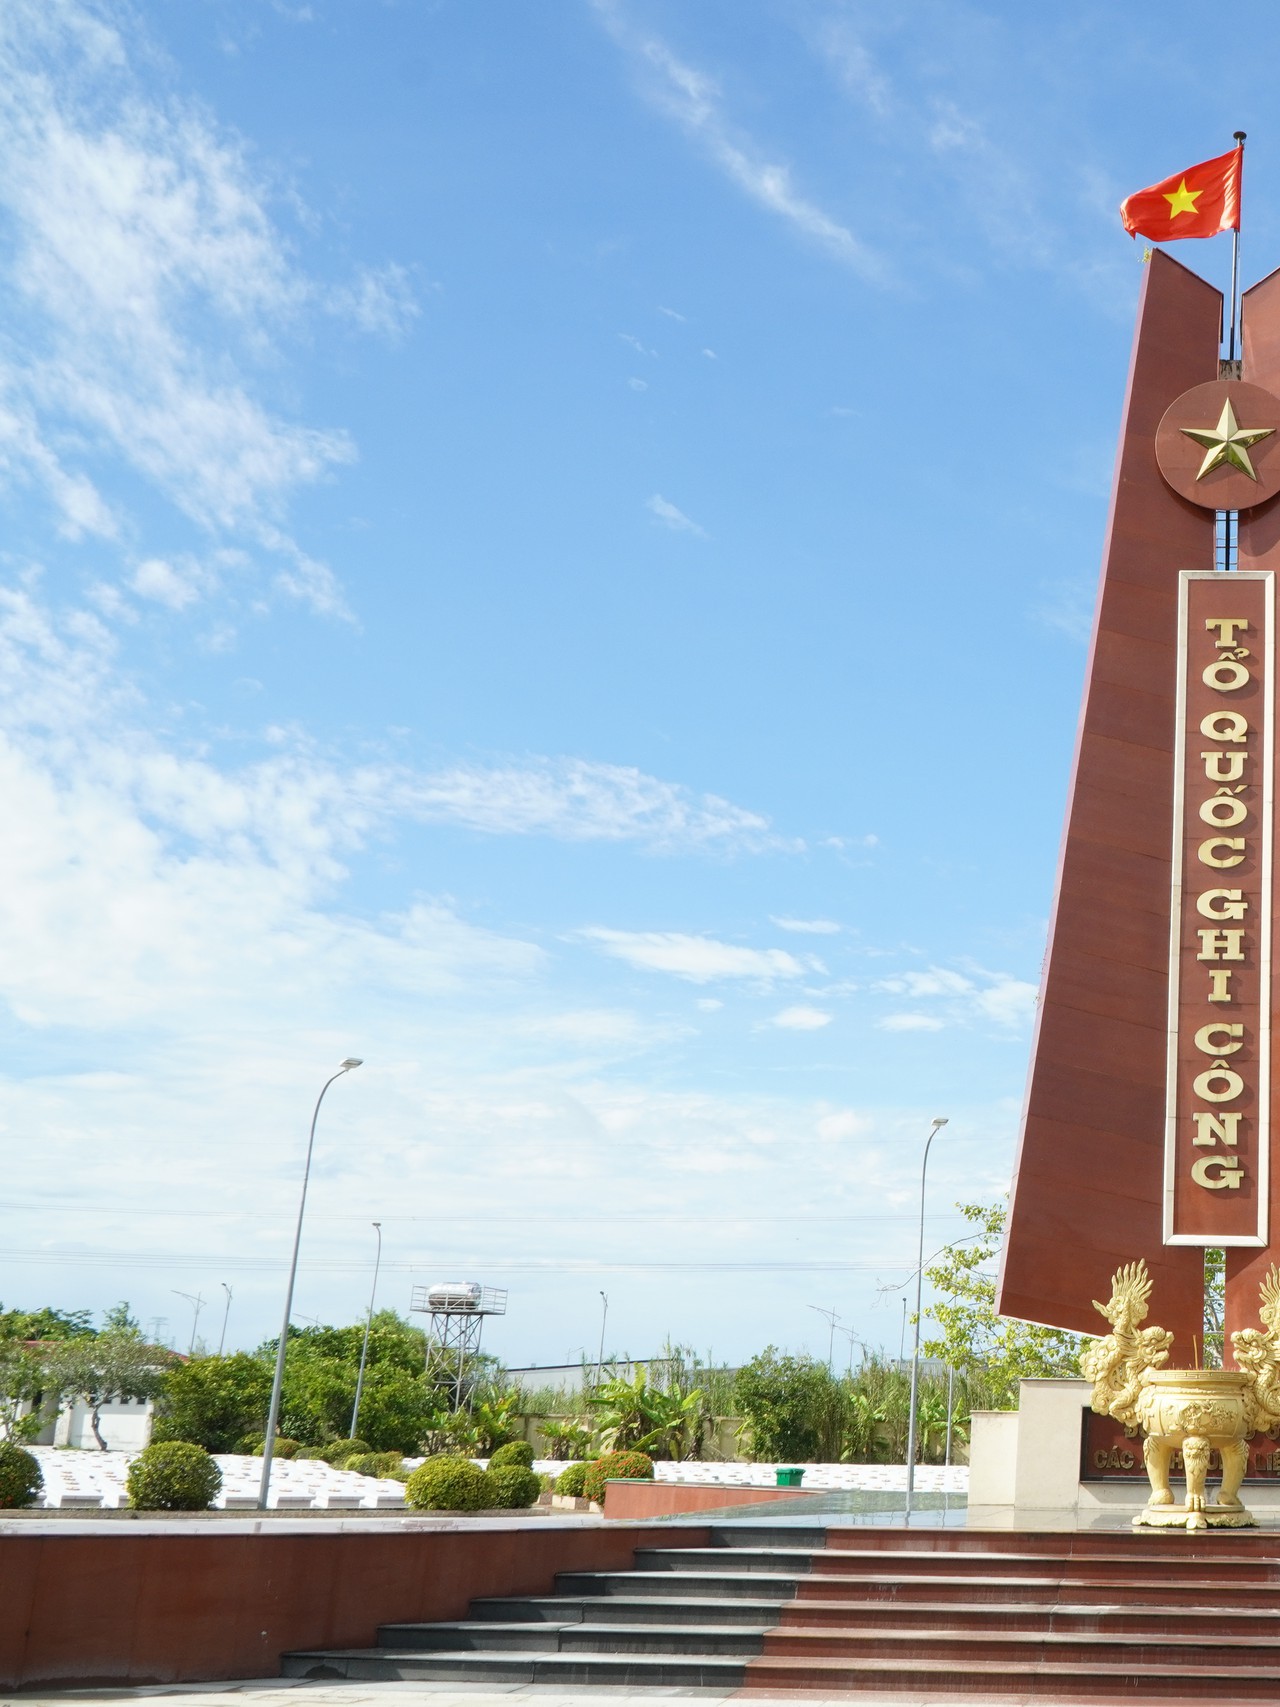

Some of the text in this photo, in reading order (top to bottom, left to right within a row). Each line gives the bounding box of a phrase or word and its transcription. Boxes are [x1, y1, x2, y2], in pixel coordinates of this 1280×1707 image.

[1191, 619, 1250, 1189] TỔ QUỐC GHI CÔNG
[1094, 1446, 1135, 1469] CÁC
